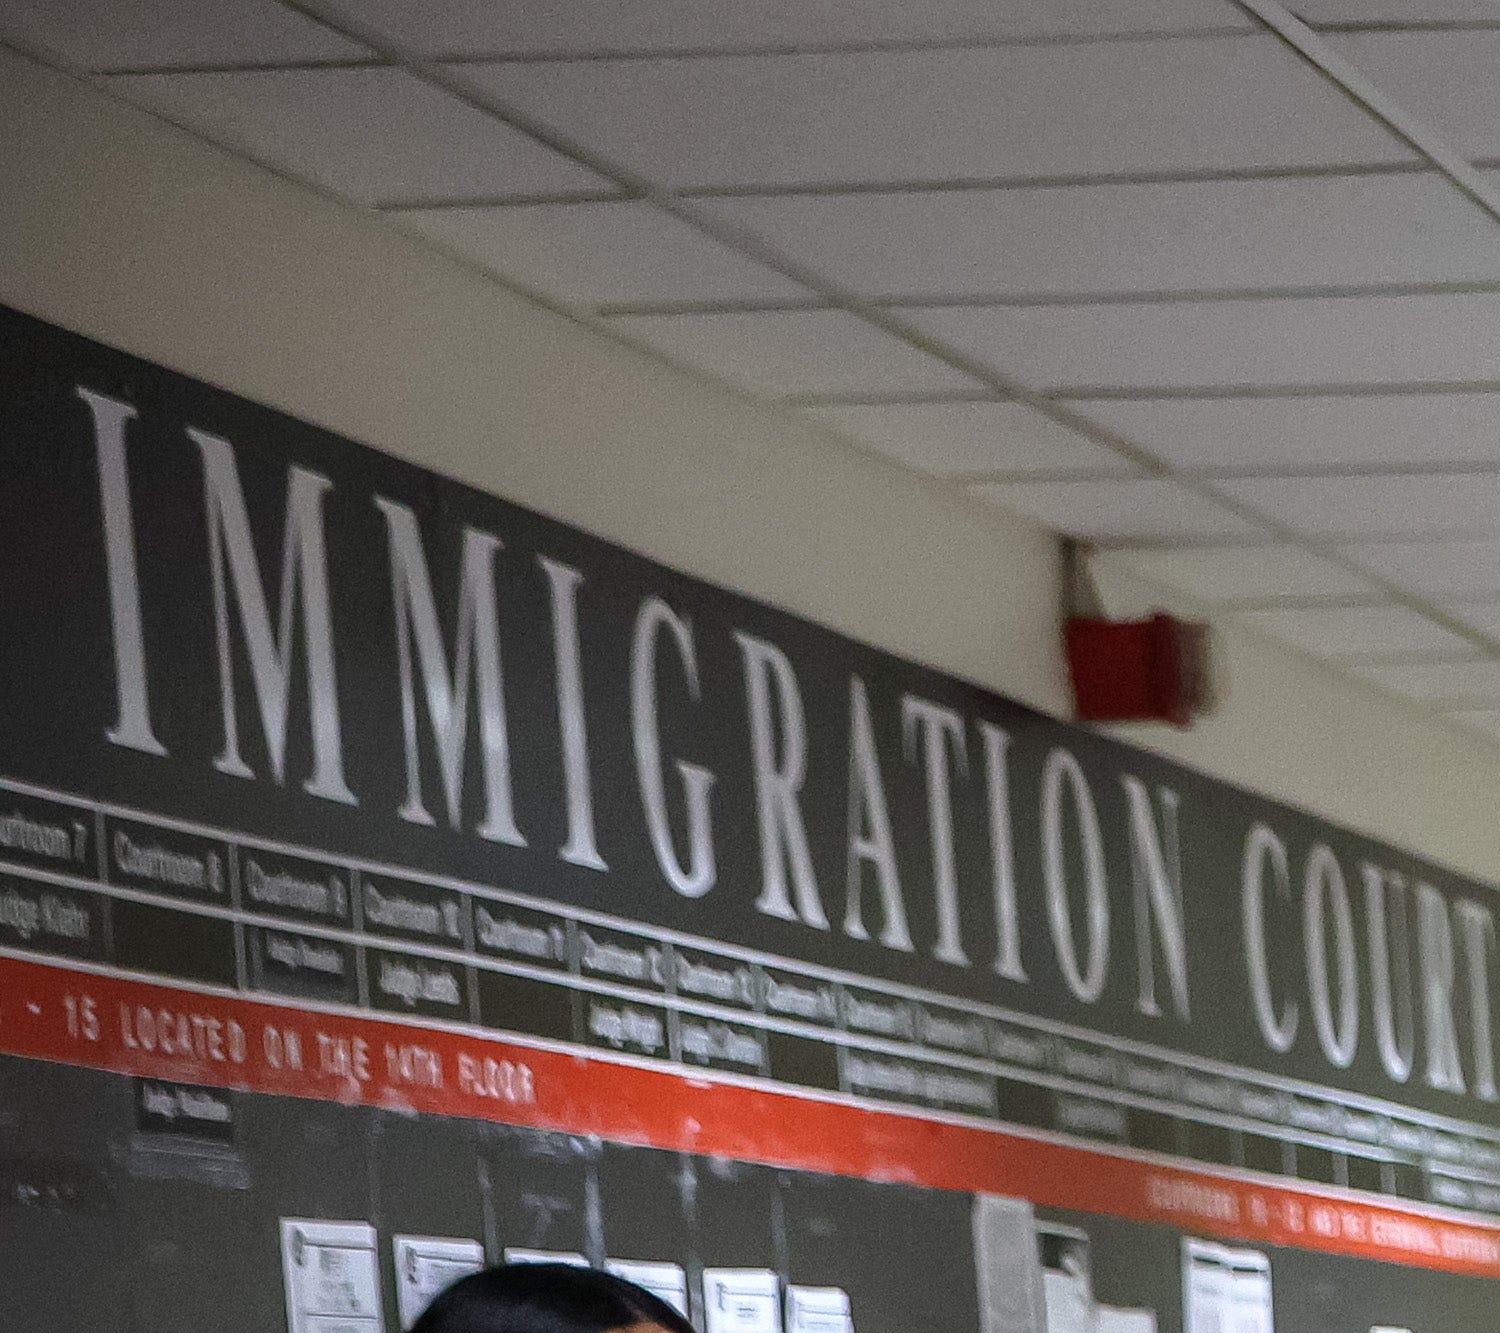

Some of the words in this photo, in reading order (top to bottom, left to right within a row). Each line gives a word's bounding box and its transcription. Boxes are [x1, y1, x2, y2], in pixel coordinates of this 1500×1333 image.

[76, 384, 1191, 1024] IMMIGRATION
[1243, 821, 1500, 1103] COURT
[120, 1002, 247, 1064] LOCATED
[263, 1025, 303, 1072] ON
[316, 1031, 372, 1081] THE
[457, 1051, 536, 1103] FLOOR
